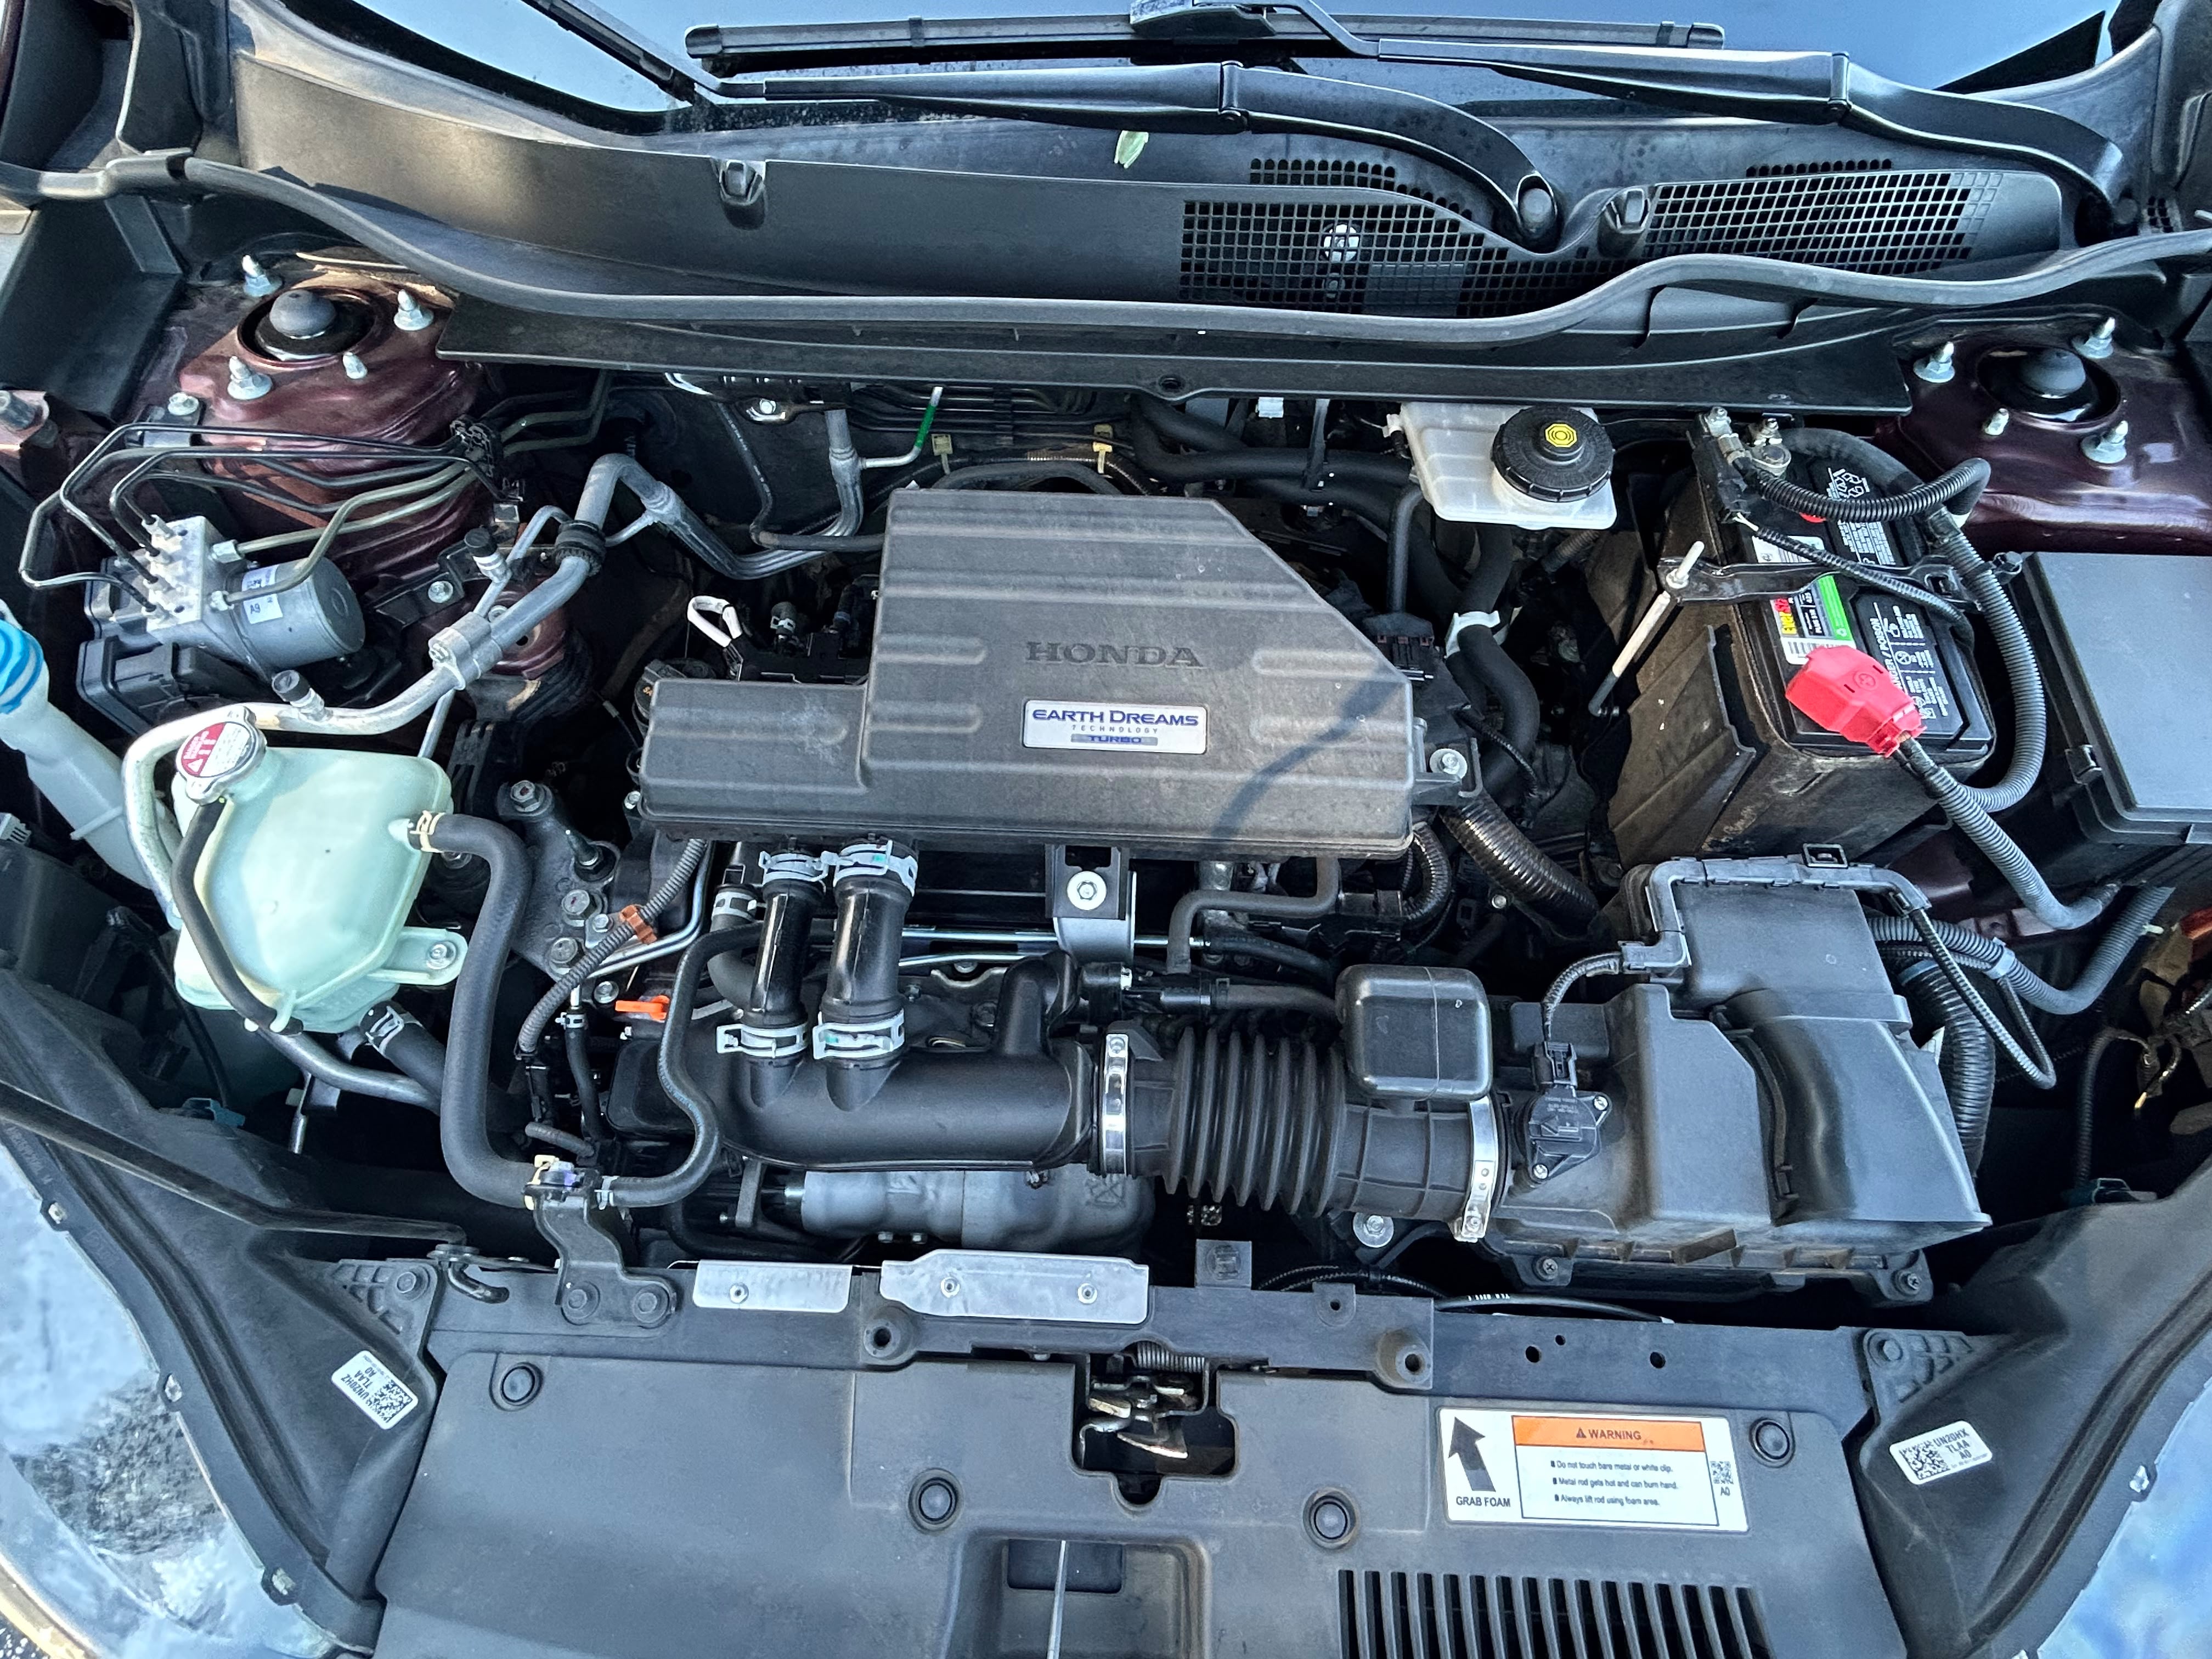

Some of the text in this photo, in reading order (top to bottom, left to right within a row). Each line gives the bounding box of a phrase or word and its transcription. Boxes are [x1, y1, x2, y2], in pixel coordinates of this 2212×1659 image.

[1025, 641, 1205, 668] HONDA
[1032, 709, 1199, 726] EARTH DREAMS
[1072, 724, 1159, 734] TECHNOLOGY
[1087, 735, 1143, 744] TURBO
[1588, 1429, 1642, 1441] WARNING
[1944, 1439, 1971, 1454] TLAA
[1556, 1460, 1566, 1469] Do
[1579, 1462, 1596, 1470] touch
[1598, 1462, 1612, 1470] bare
[1559, 1477, 1576, 1485] Metal
[1590, 1479, 1604, 1488] gets
[1643, 1480, 1659, 1488] burn
[1660, 1481, 1678, 1489] hand.
[1456, 1496, 1511, 1507] GRAB FOAM
[1561, 1494, 1583, 1505] Always
[1584, 1494, 1593, 1503] lift
[1594, 1496, 1605, 1504] rod
[1607, 1497, 1624, 1506] using
[1625, 1496, 1641, 1505] foam
